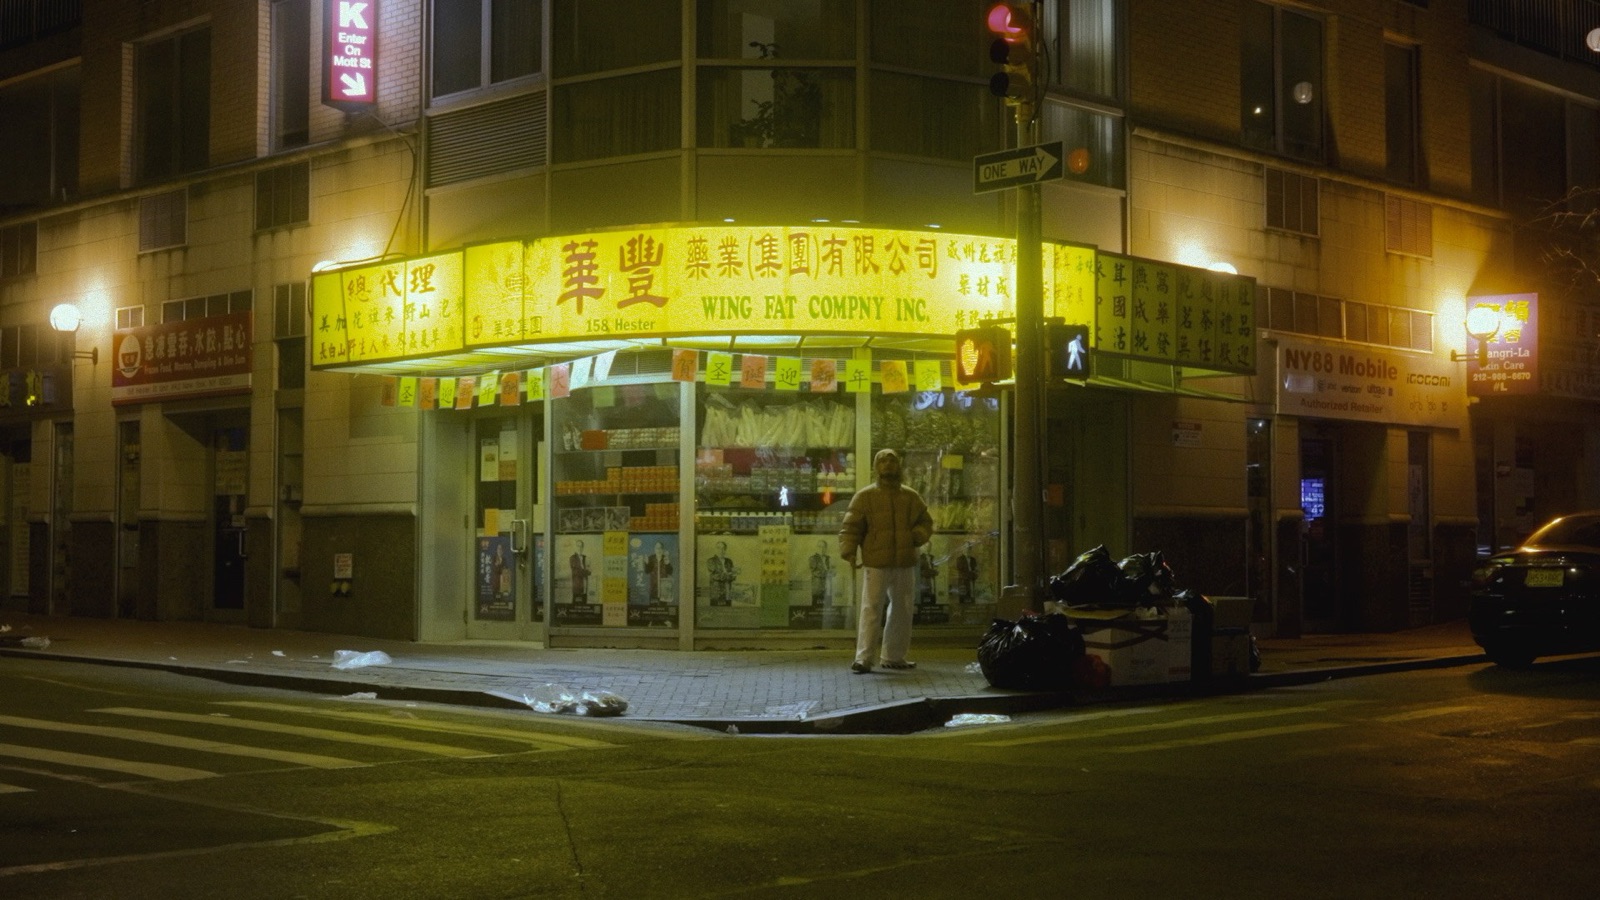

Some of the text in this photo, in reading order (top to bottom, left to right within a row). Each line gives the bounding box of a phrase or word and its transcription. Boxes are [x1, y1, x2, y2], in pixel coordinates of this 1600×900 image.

[338, 32, 367, 45] Enter
[344, 44, 361, 56] On
[333, 55, 371, 69] Mott St
[983, 156, 1045, 180] ONE WAY
[347, 263, 437, 303] 總代理
[701, 296, 930, 323] WING FAT COMPNY INC.
[615, 317, 656, 331] Hester
[1474, 348, 1530, 361] Sangri-La
[1285, 348, 1398, 380] NY88 Mobile
[1503, 361, 1525, 370] Care
[1300, 398, 1383, 414] Authorized Retailer
